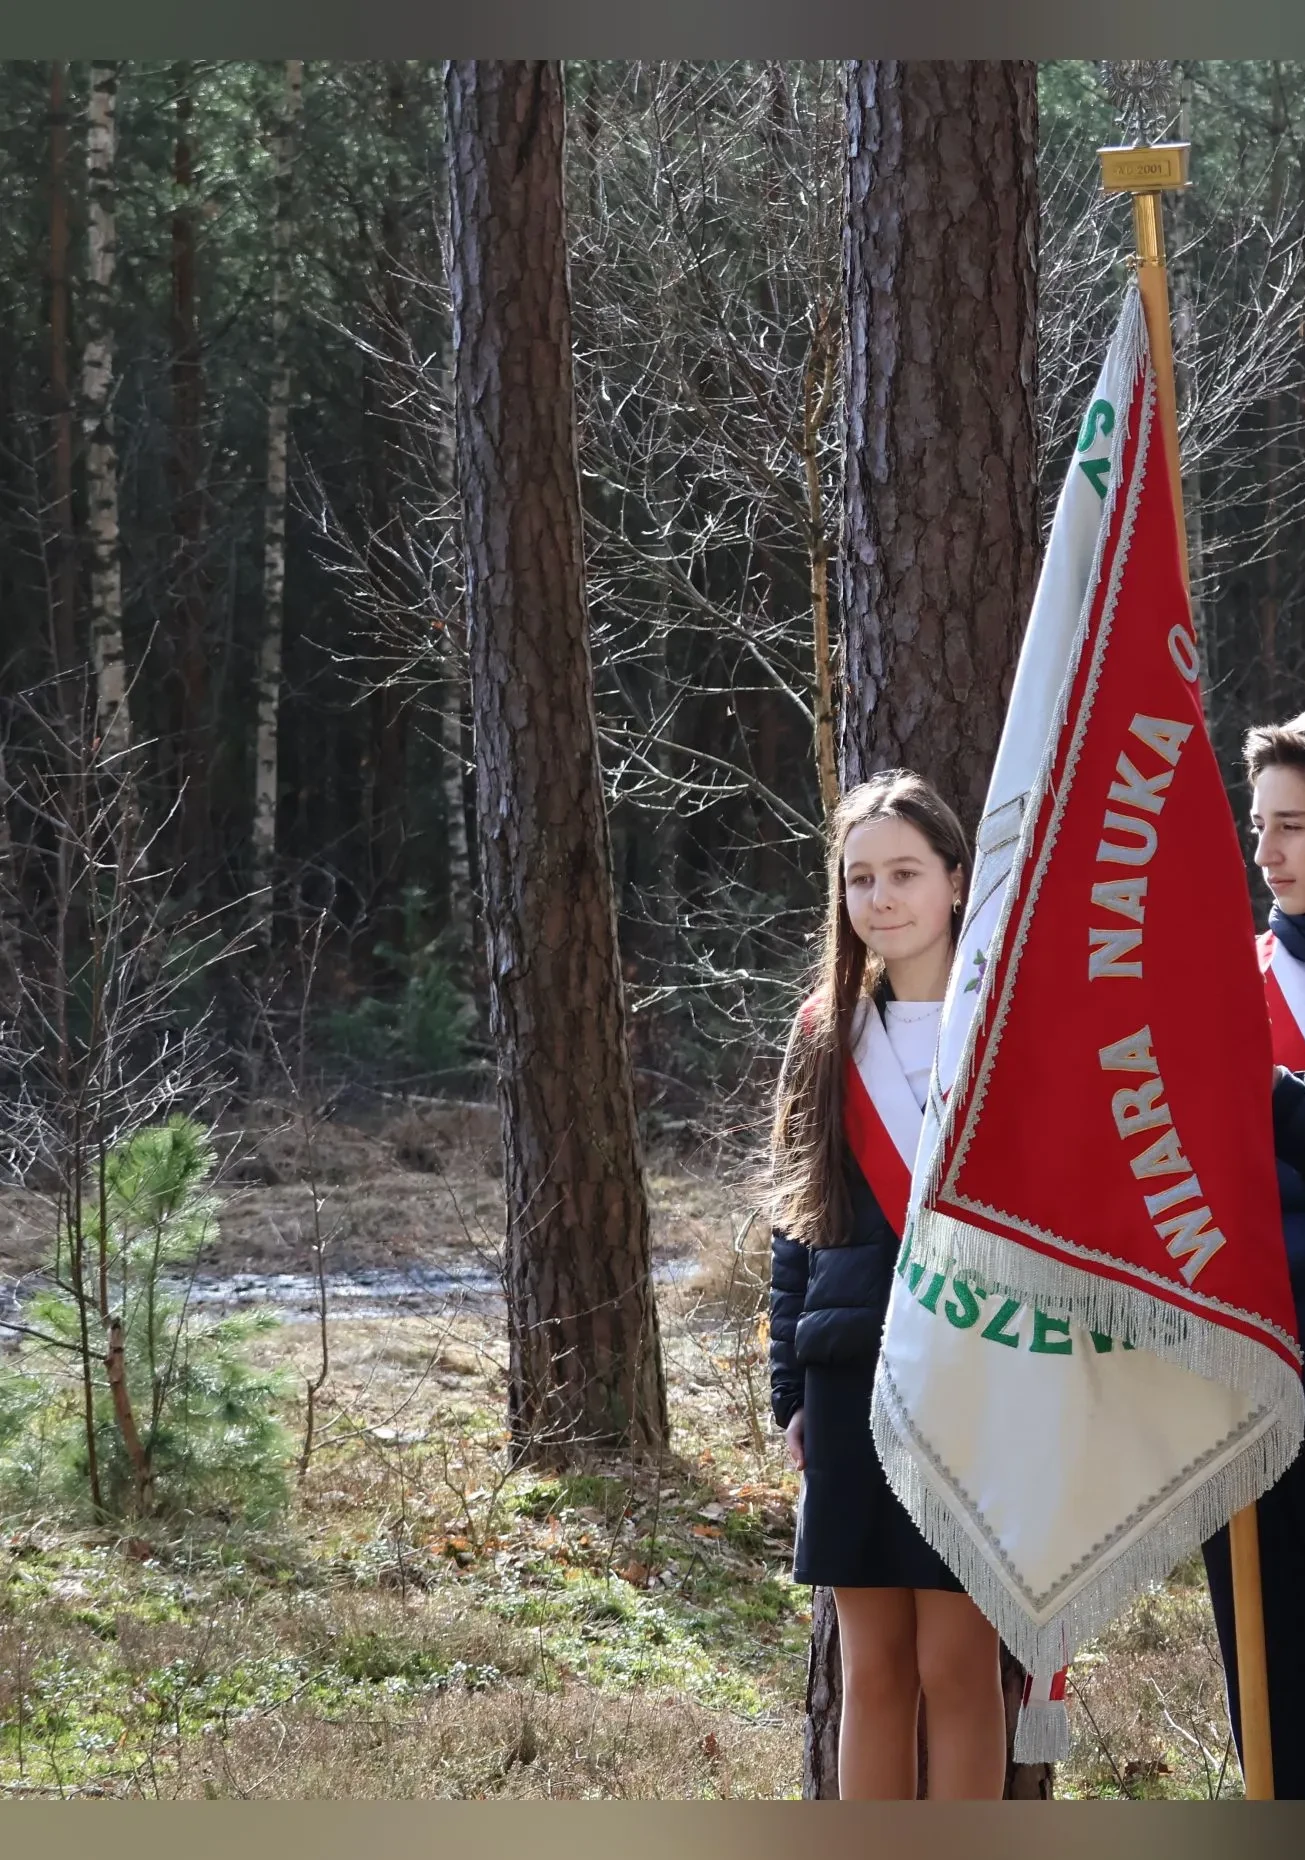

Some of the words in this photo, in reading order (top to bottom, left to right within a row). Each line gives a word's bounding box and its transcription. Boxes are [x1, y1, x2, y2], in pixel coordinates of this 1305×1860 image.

[1137, 163, 1163, 175] 2001
[1088, 713, 1194, 982] NAUKA
[1098, 1024, 1226, 1285] WIARA
